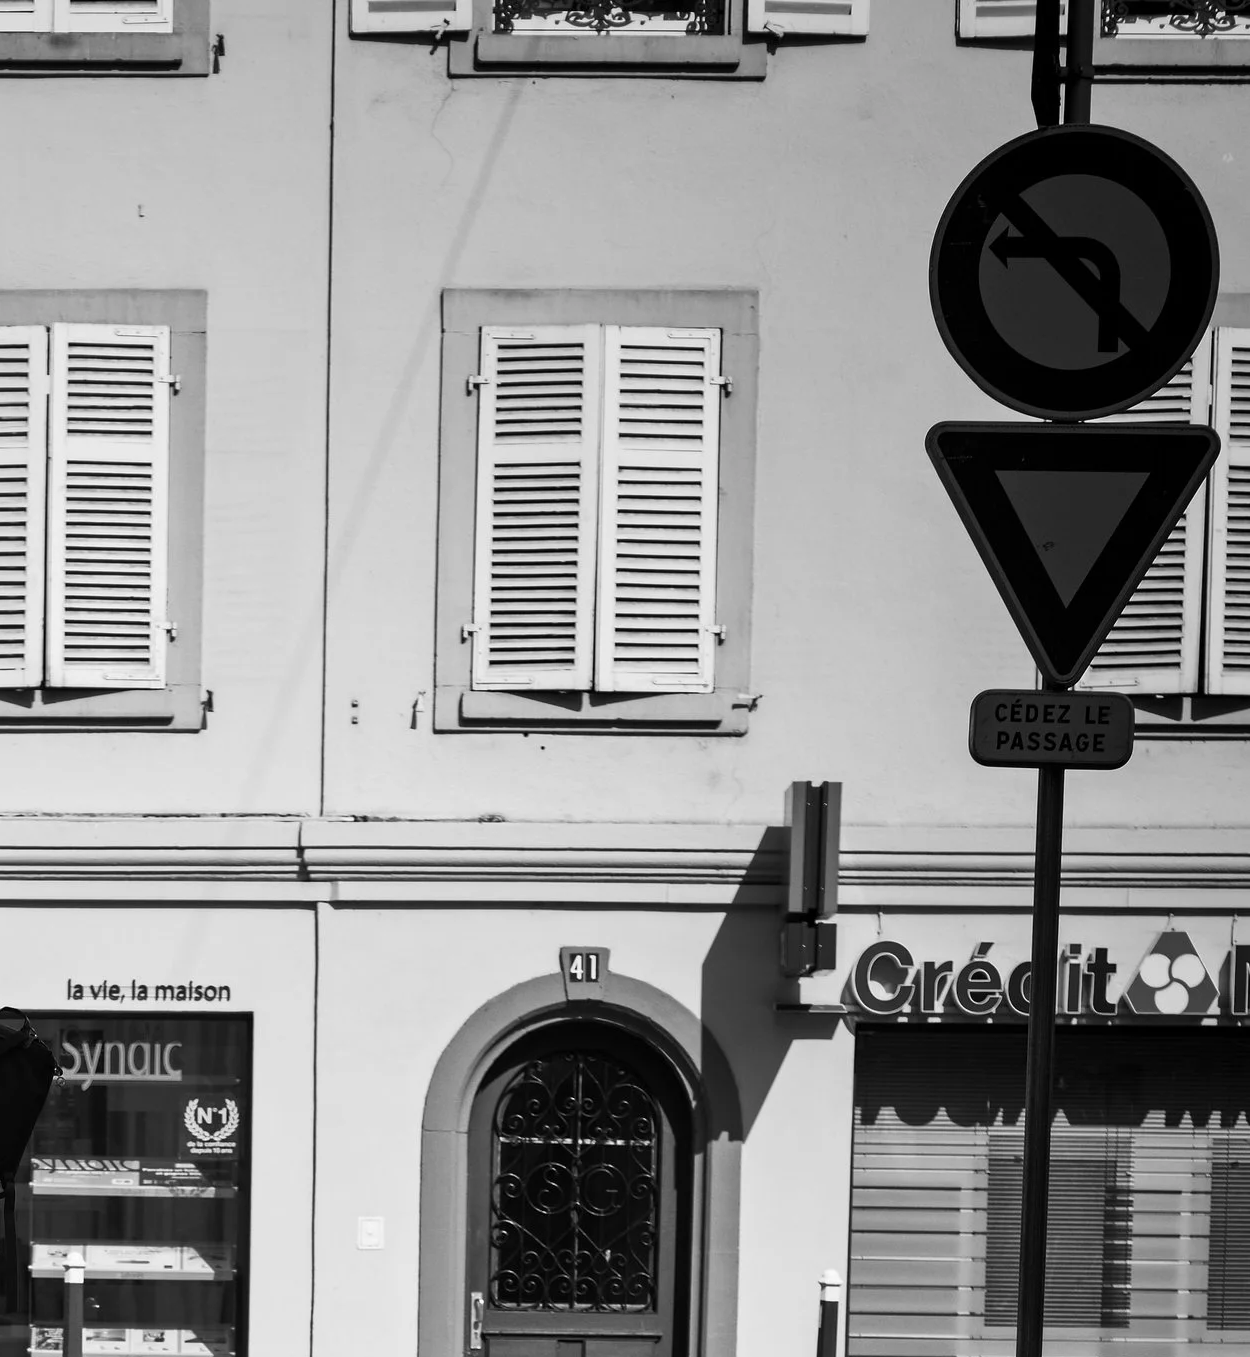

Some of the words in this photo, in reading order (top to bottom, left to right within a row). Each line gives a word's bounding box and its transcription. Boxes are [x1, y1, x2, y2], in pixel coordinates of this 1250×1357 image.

[995, 699, 1071, 724] CÉDEZ
[1085, 705, 1111, 725] LE
[996, 731, 1106, 752] PASSAGE
[569, 954, 598, 980] 41
[67, 978, 84, 1001] la
[90, 979, 125, 1004] vie,
[132, 978, 148, 1001] la
[155, 980, 231, 1002] maison
